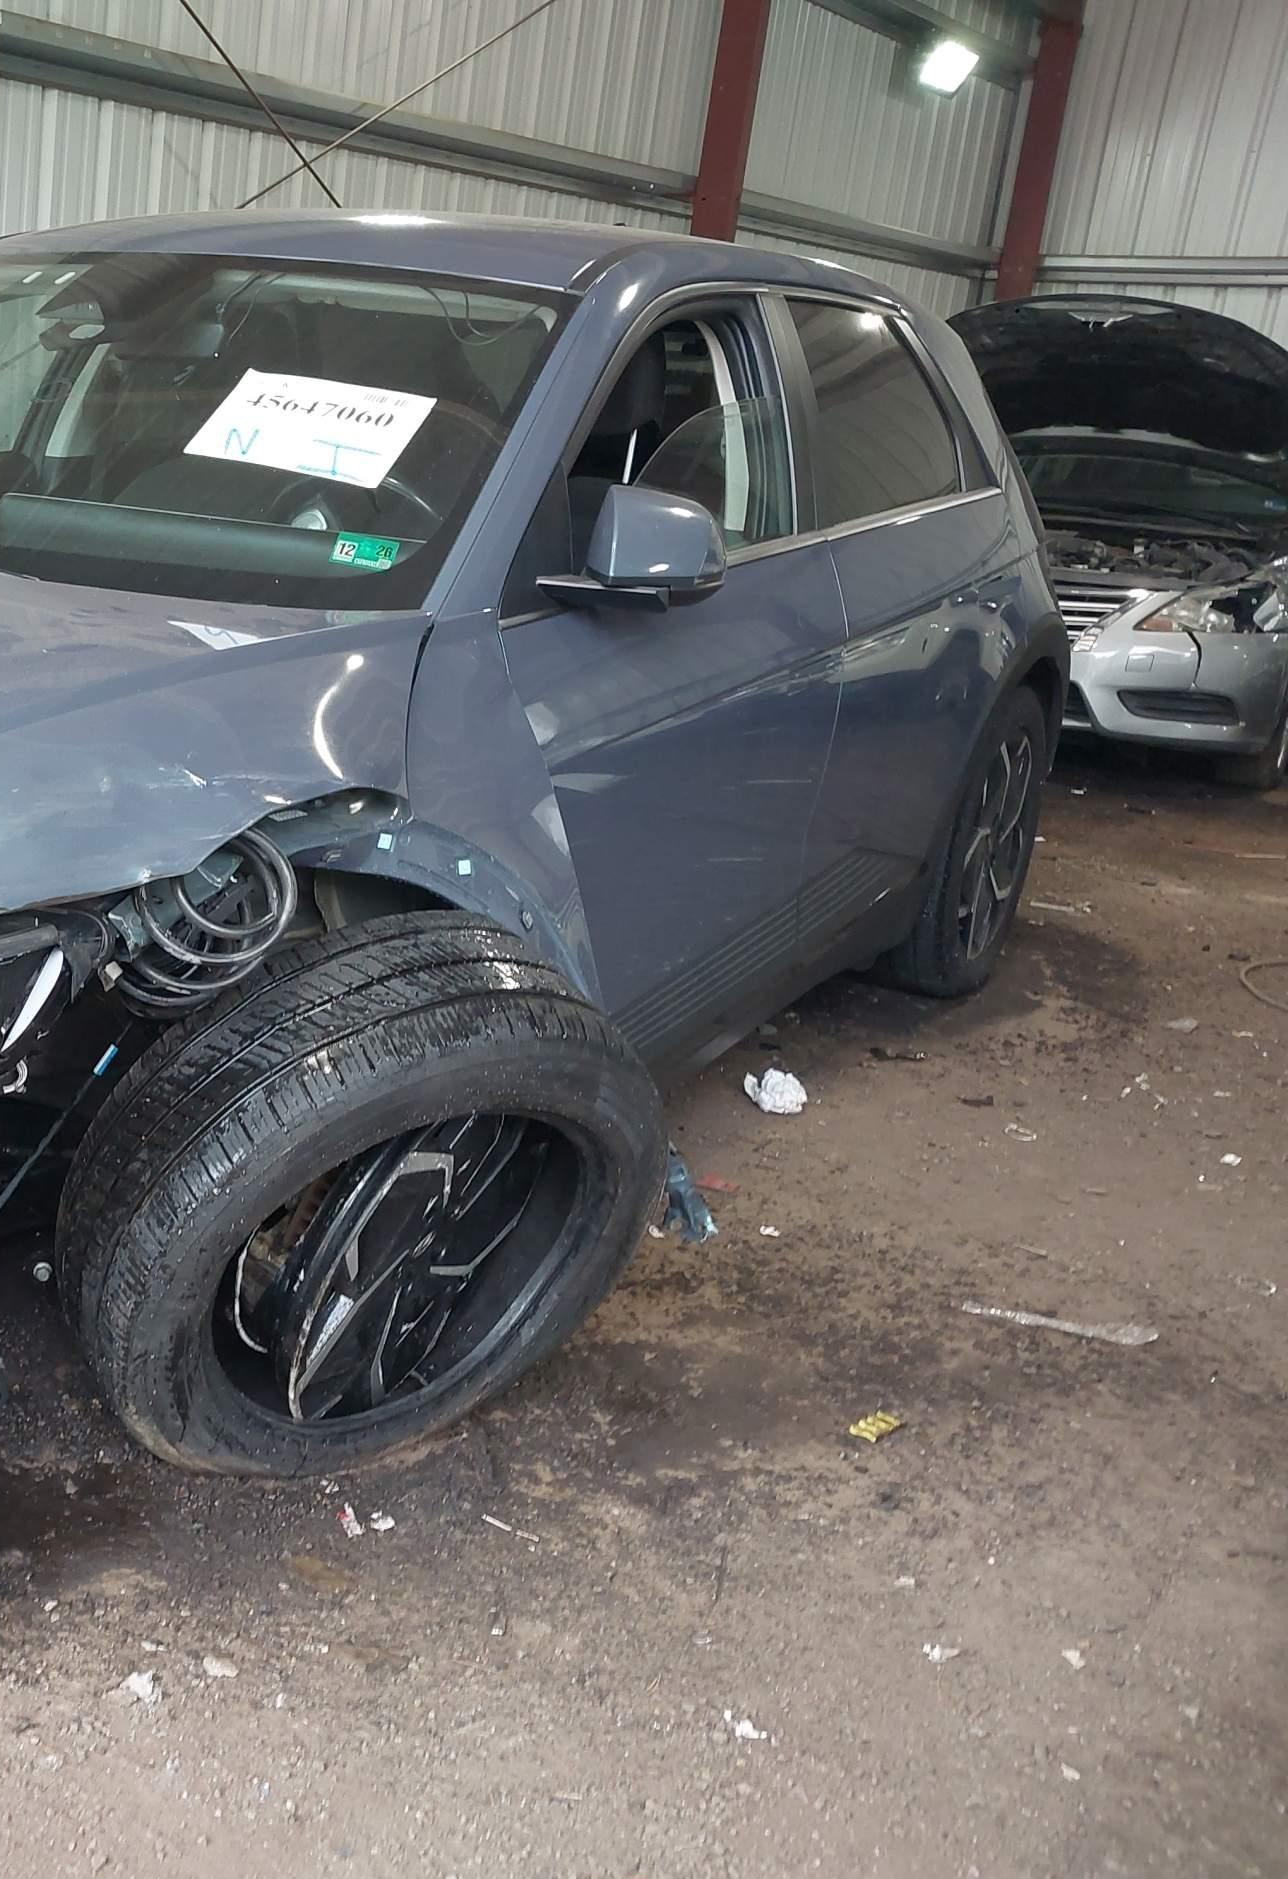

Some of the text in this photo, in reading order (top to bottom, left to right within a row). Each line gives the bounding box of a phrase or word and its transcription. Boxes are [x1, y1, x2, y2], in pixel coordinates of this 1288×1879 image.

[246, 393, 395, 427] 45647060
[338, 542, 356, 557] 12
[376, 545, 394, 558] 26
